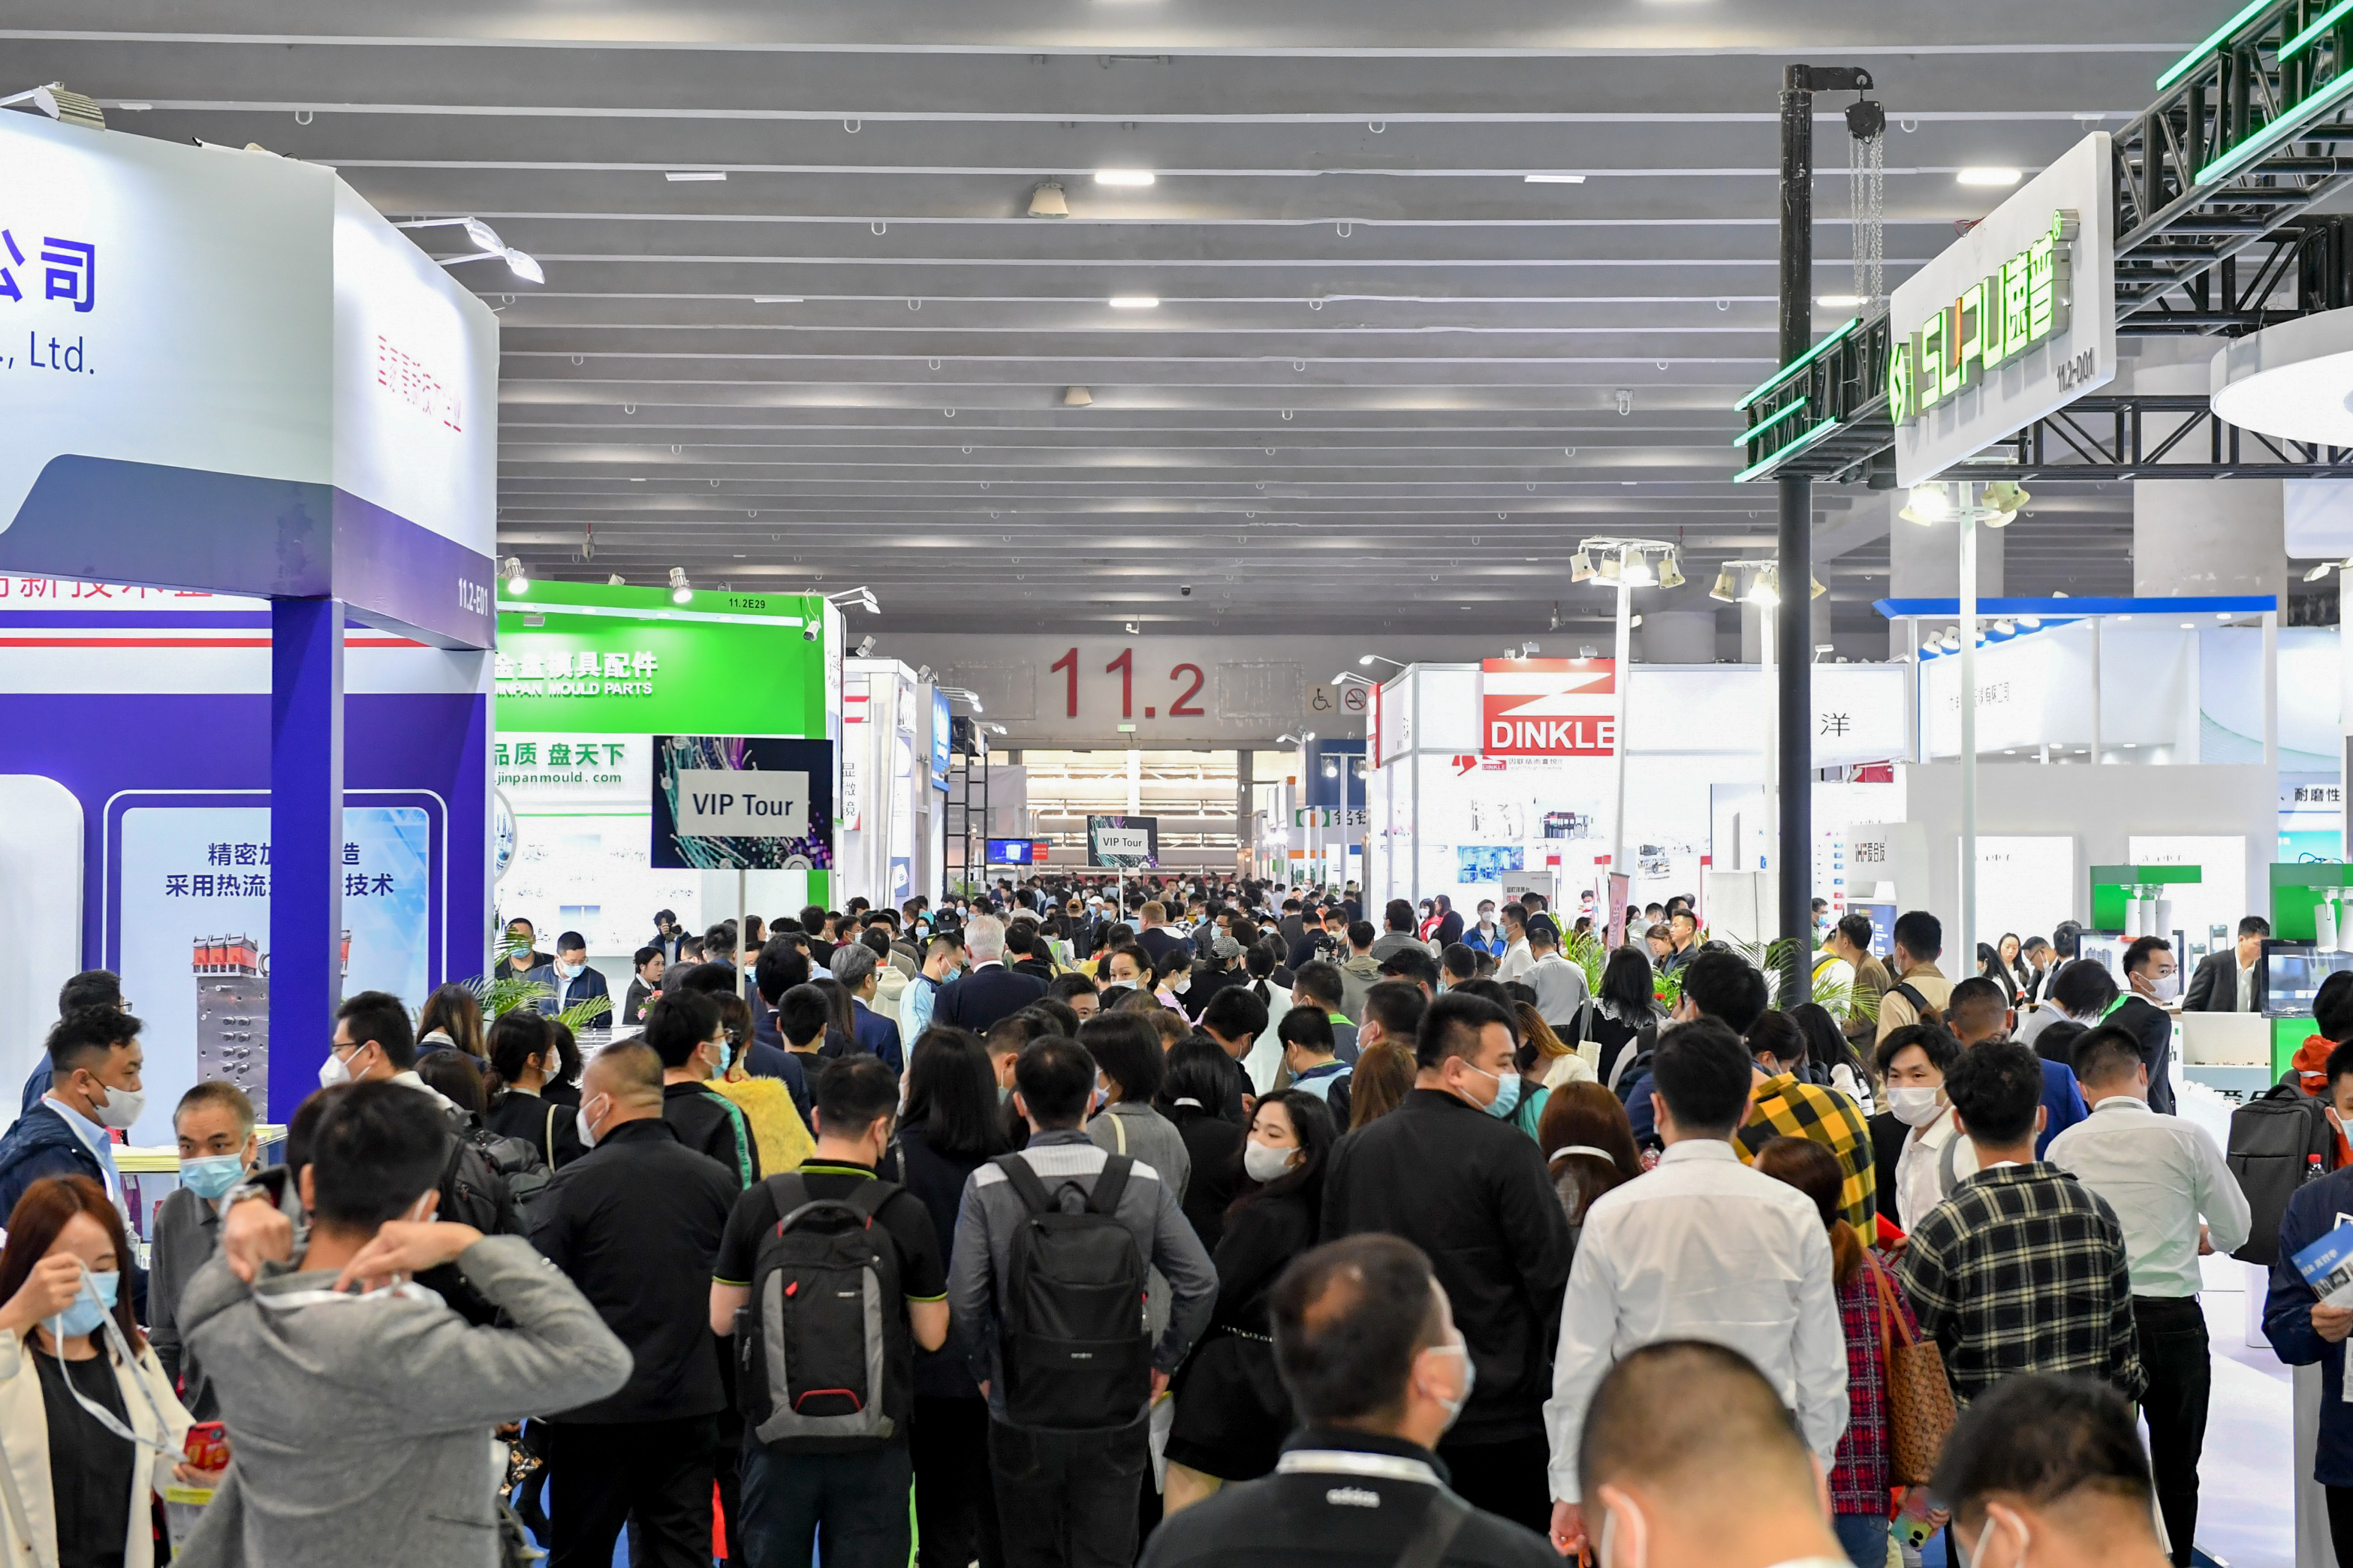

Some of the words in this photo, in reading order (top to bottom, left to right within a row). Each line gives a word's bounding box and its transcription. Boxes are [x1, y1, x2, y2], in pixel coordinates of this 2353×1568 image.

[31, 331, 95, 375] Ltd.
[2056, 346, 2095, 393] 11.2-D01
[459, 577, 488, 616] 11.2-E01
[729, 597, 766, 609] 11.2E29
[548, 682, 600, 697] MOULD
[604, 682, 653, 697] PARTS
[1051, 647, 1205, 718] 11.2
[1490, 721, 1615, 749] DINKLE
[547, 742, 625, 766] 盘天下
[692, 793, 734, 815] VIP
[742, 794, 794, 817] Tour
[1102, 837, 1119, 847] VIP
[1122, 838, 1143, 847] Tour
